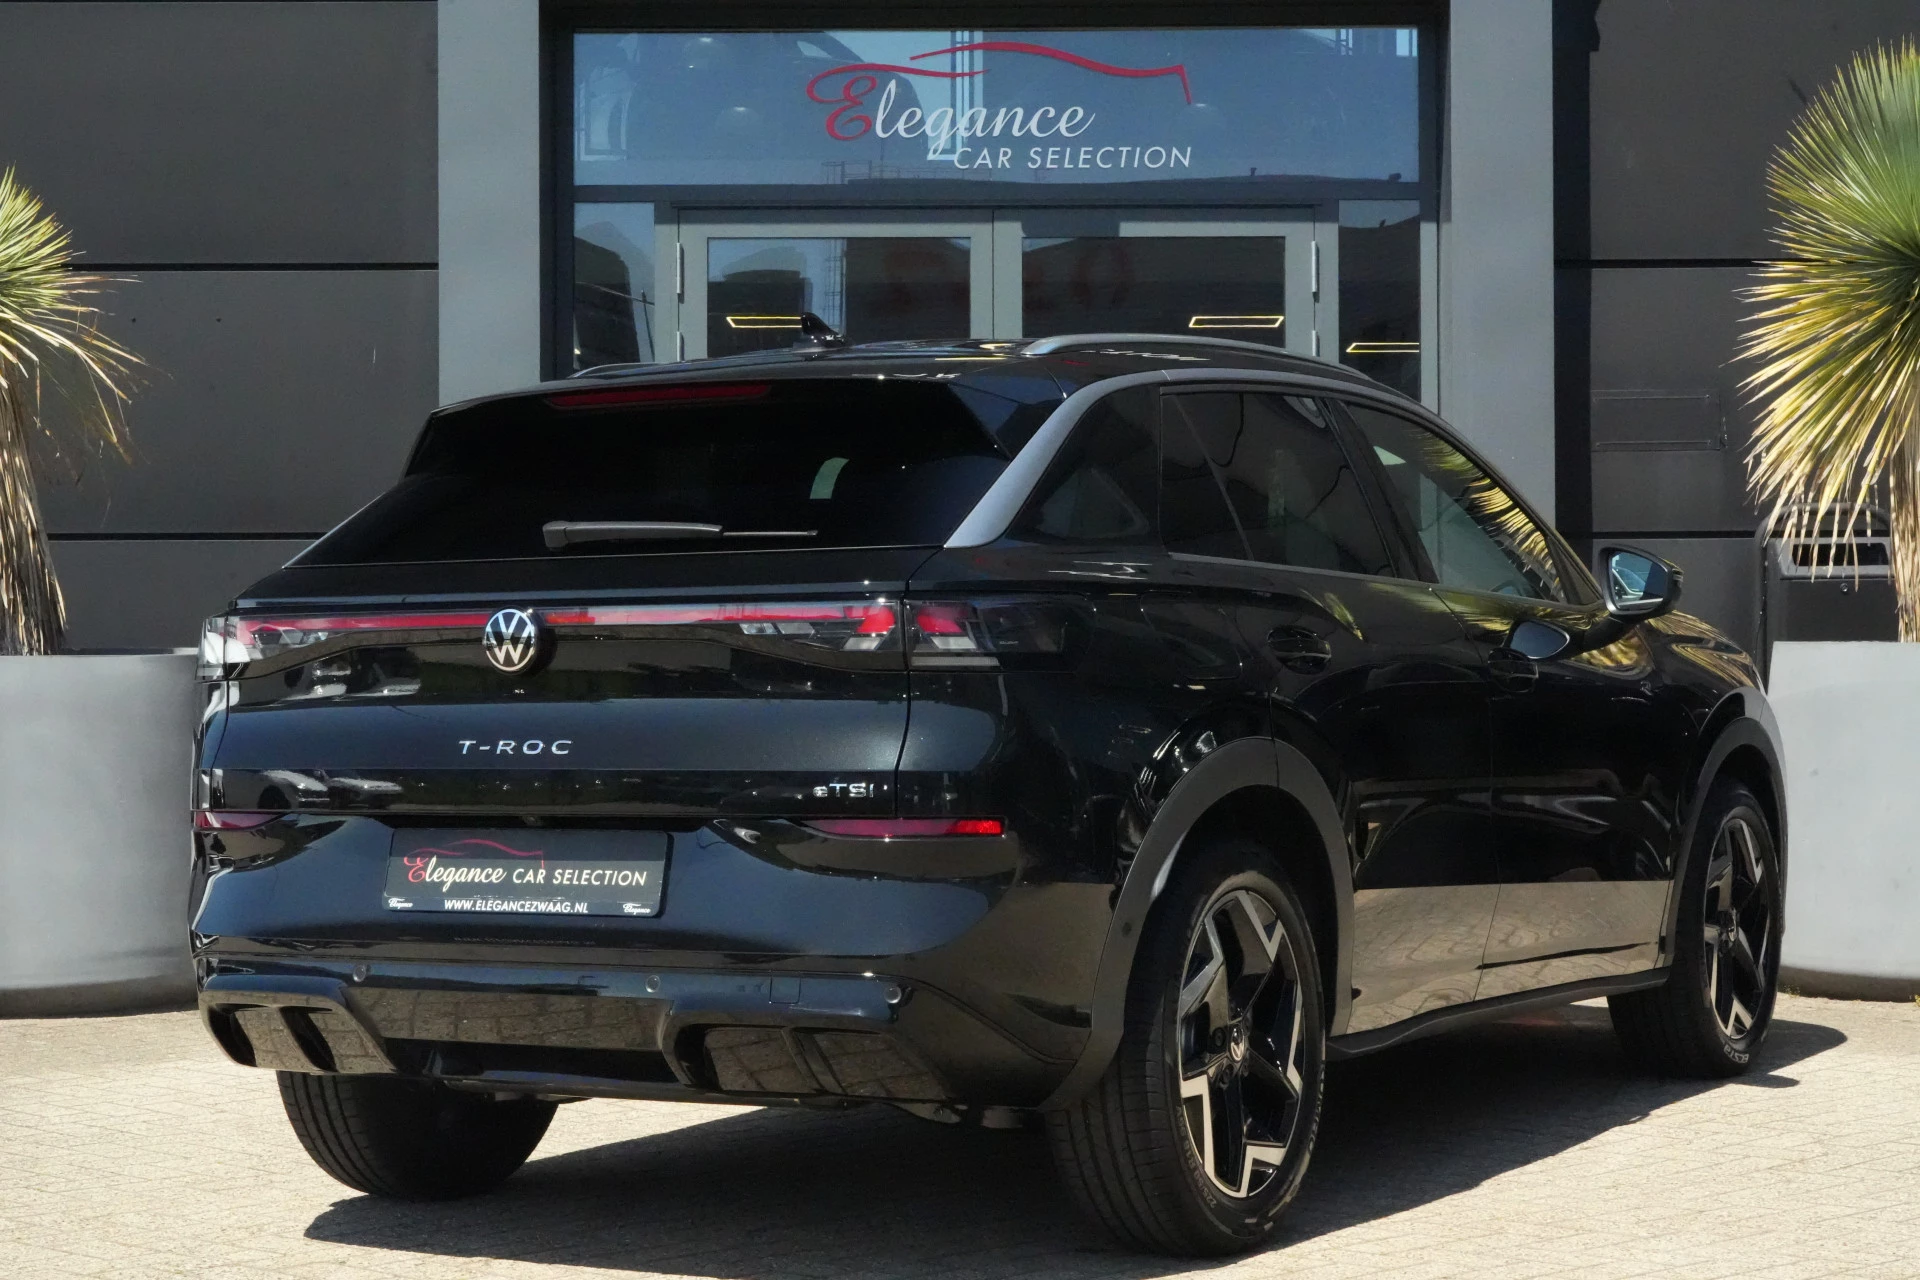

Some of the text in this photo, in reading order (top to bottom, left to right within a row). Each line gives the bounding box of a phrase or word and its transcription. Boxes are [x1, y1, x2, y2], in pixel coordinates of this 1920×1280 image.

[806, 63, 1096, 160] Elegance
[954, 146, 1192, 169] CAR SELECTION
[458, 739, 573, 755] T-ROC
[812, 782, 875, 798] eTSI
[403, 854, 647, 893] Elegance CAR SELECTION
[444, 899, 589, 914] WWW.ELEGANCEZWAAG.NL
